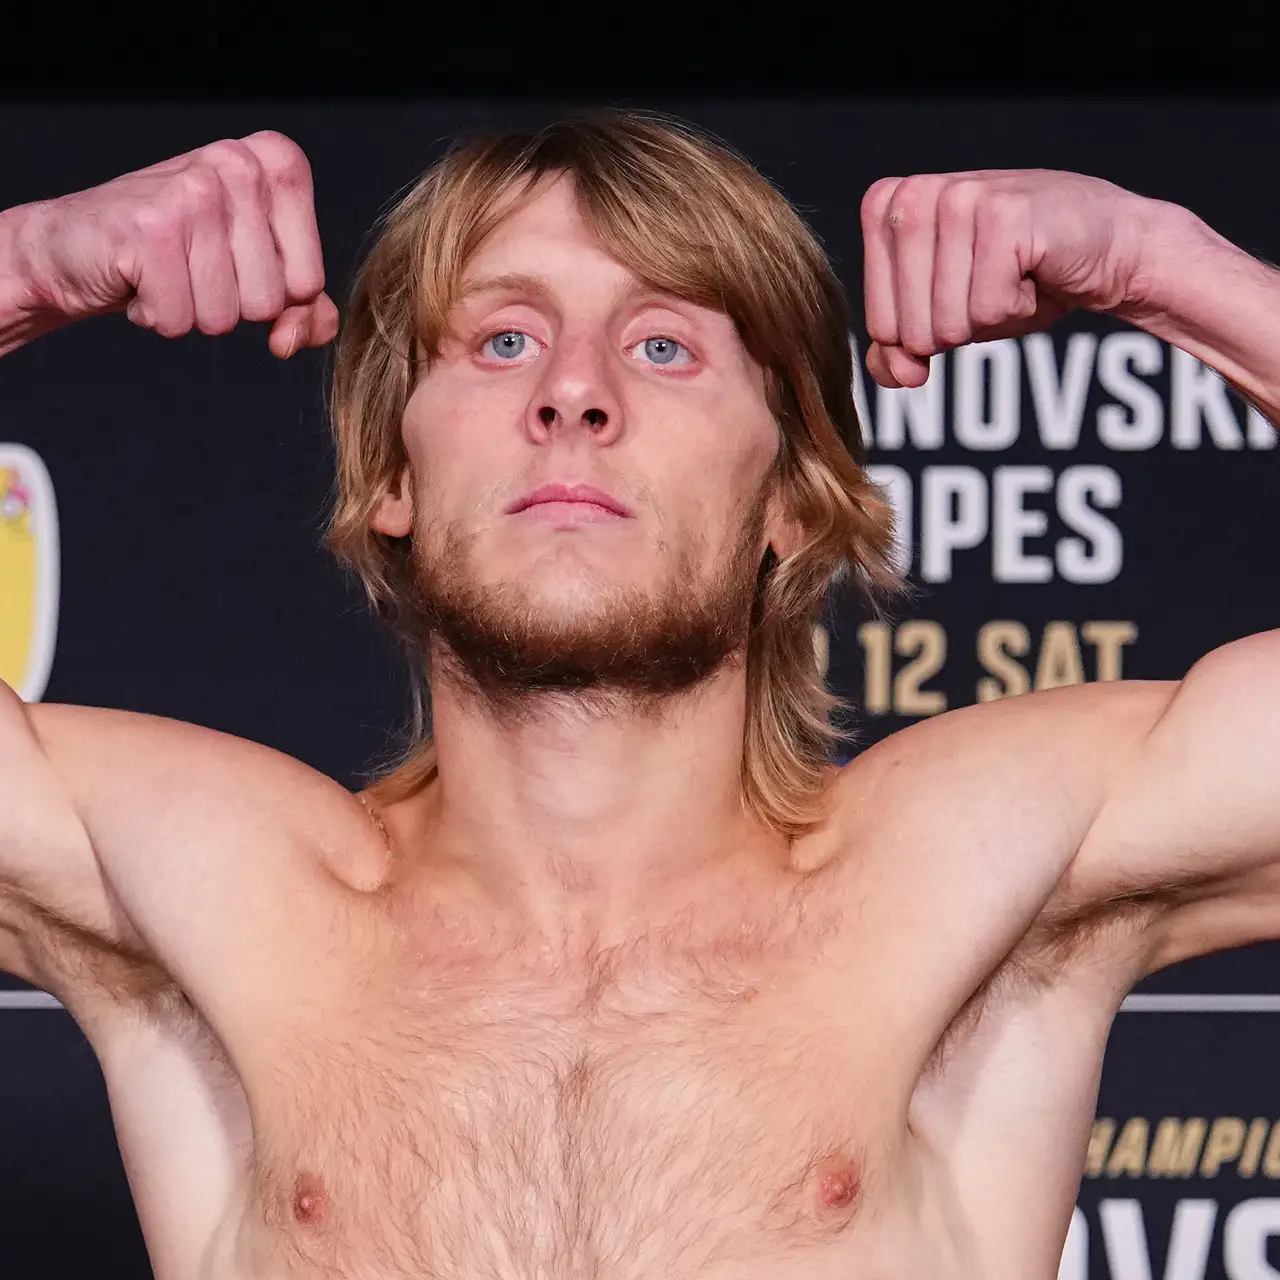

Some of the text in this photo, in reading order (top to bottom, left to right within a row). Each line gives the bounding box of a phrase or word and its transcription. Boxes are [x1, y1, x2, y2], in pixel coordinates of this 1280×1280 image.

[850, 330, 1278, 451] NOVSK
[857, 619, 948, 716] 12
[976, 619, 1138, 703] SAT
